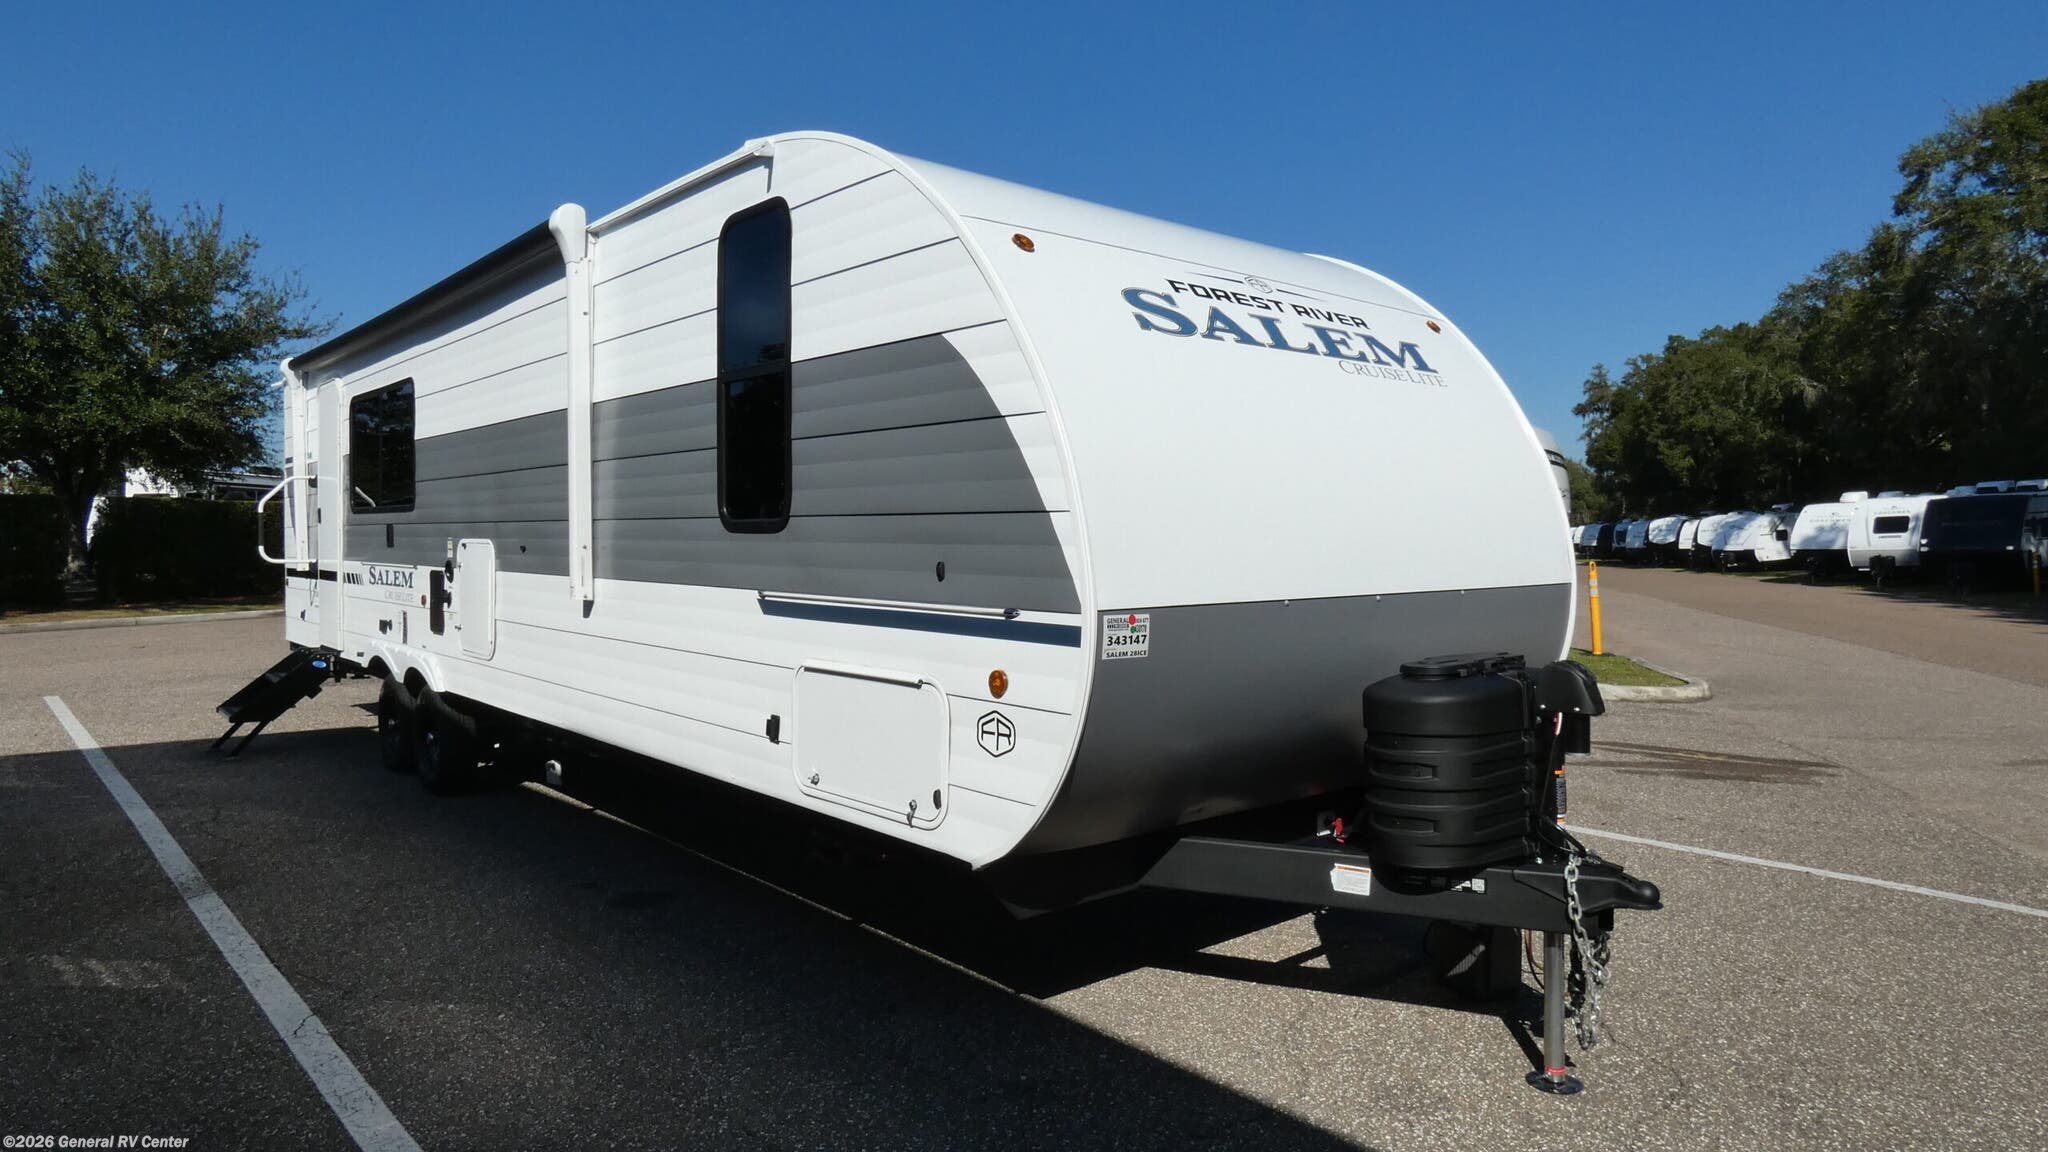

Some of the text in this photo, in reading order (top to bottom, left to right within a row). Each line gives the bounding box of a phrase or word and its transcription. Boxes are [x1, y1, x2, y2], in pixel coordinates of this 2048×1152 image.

[1166, 279, 1370, 329] FOREST RIVER
[1120, 286, 1439, 374] SALEM
[368, 566, 414, 589] SALEM
[1106, 635, 1147, 646] 343147
